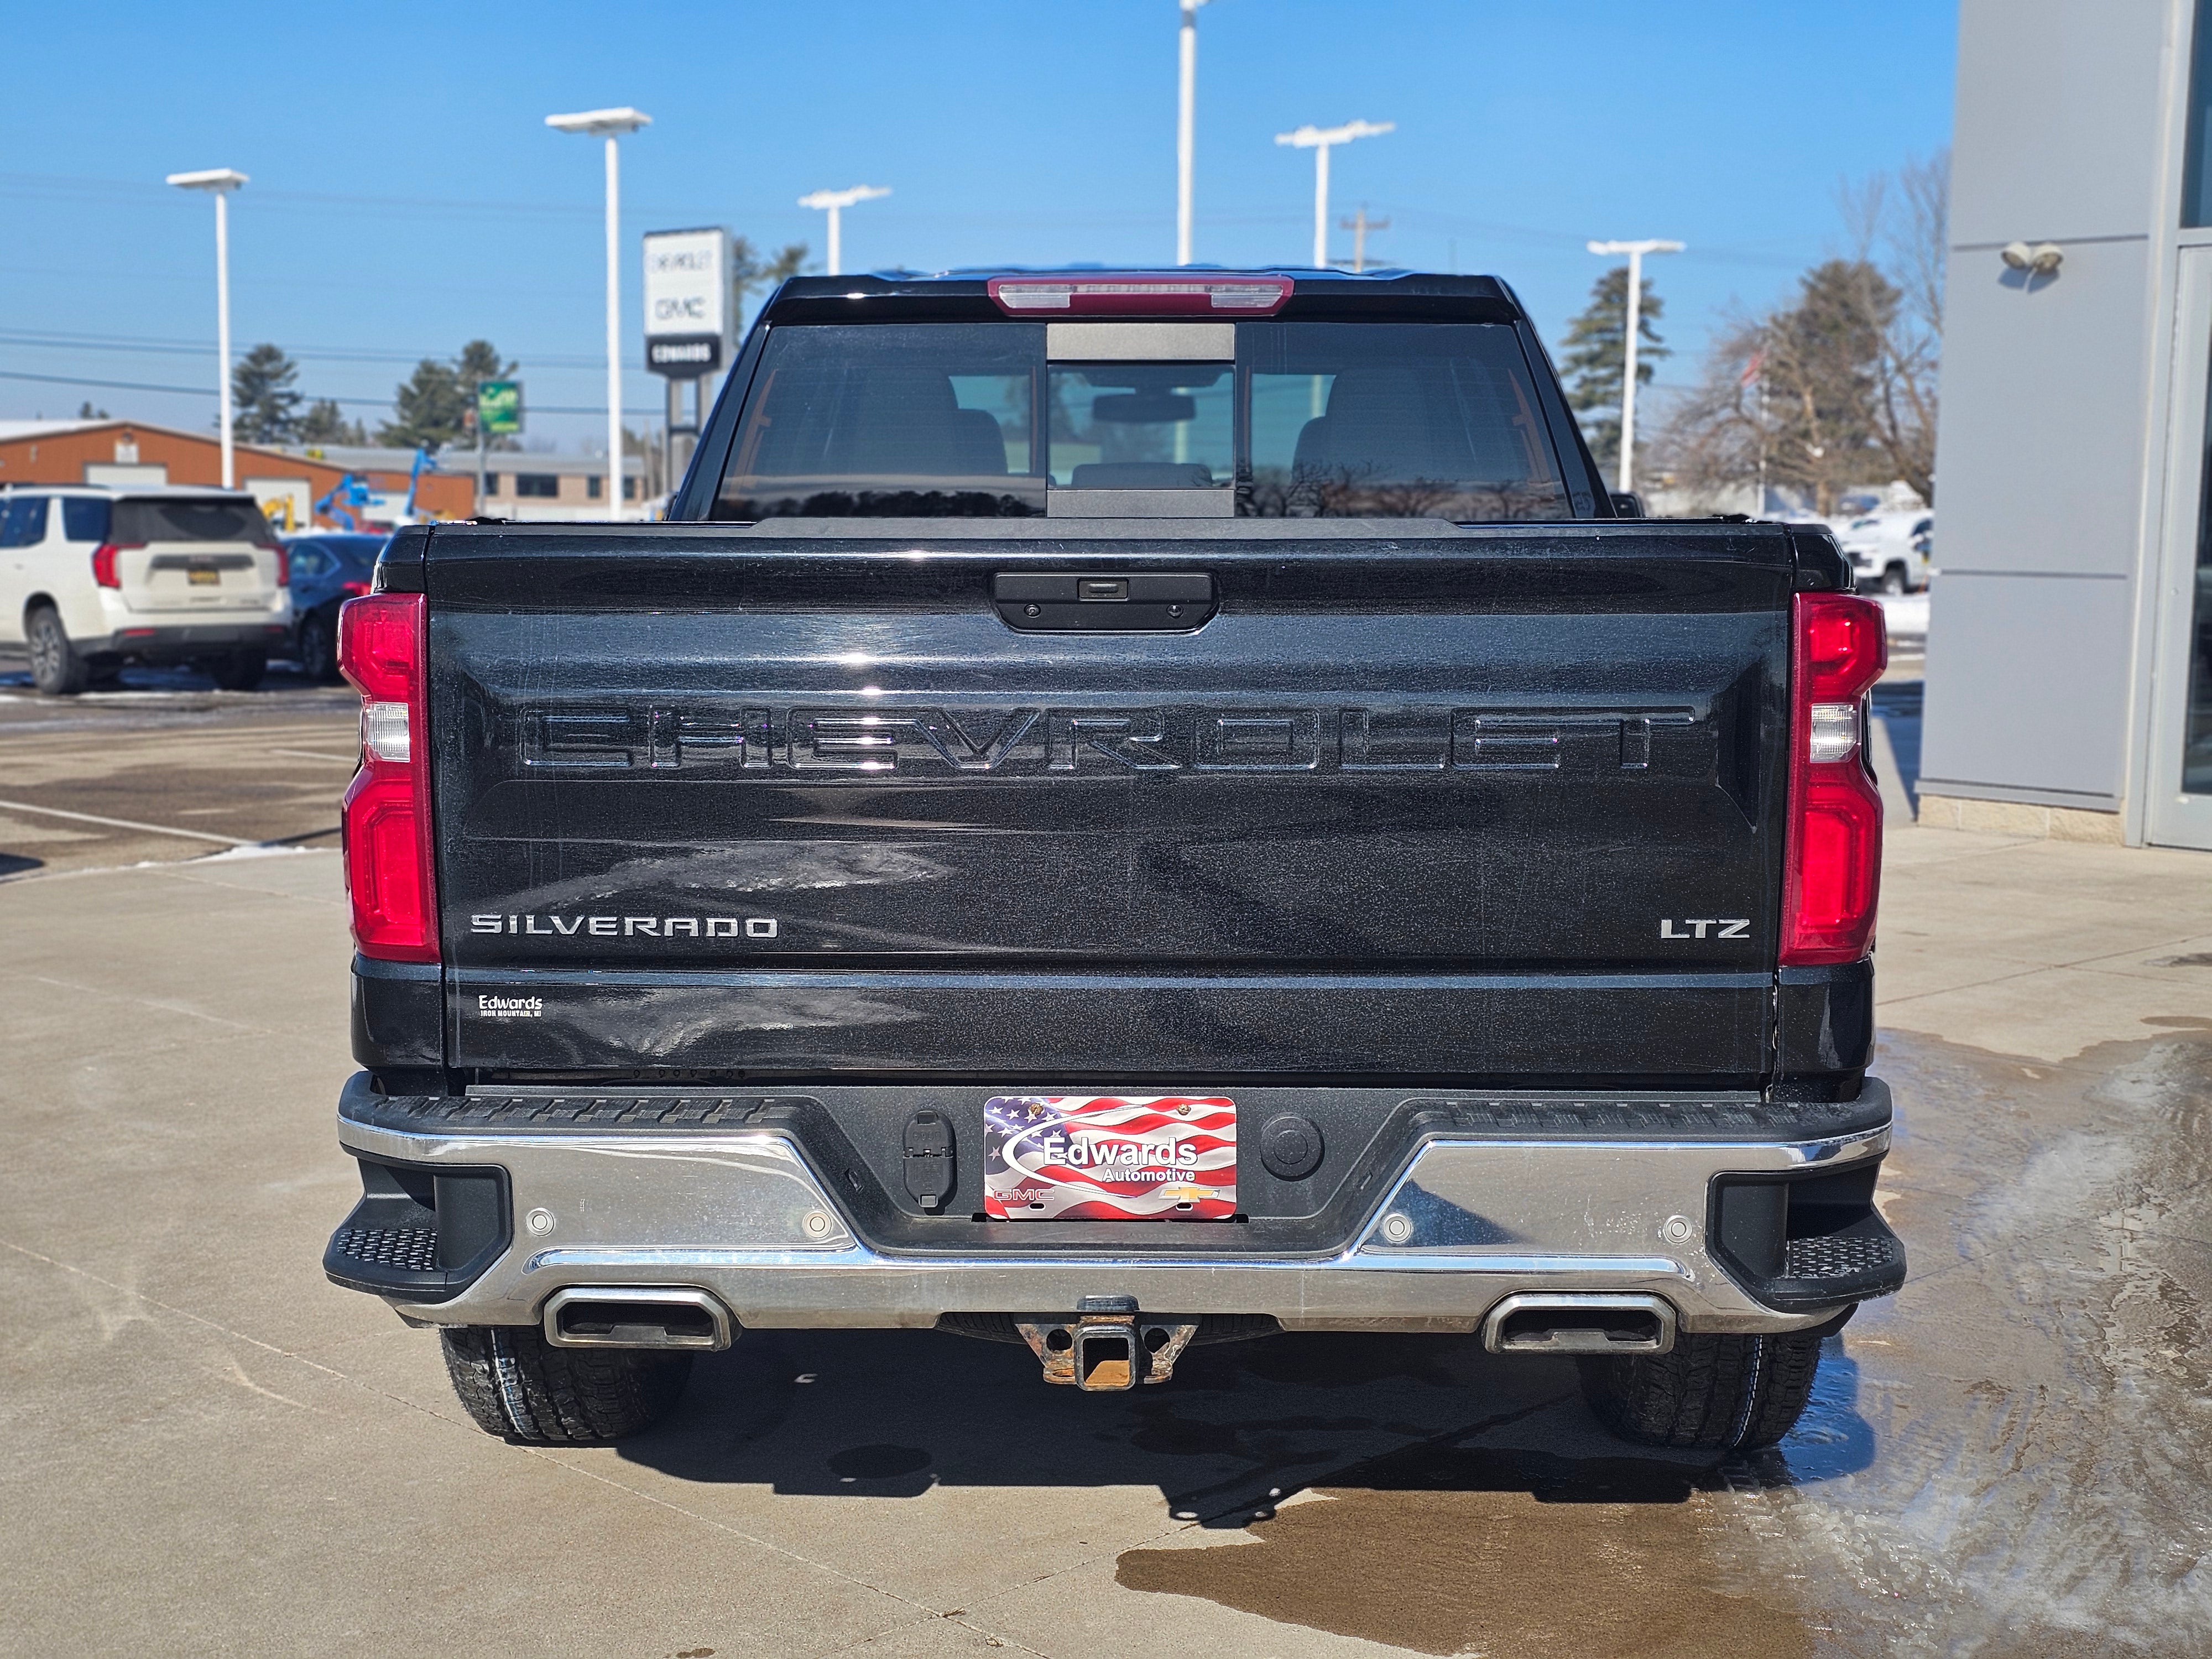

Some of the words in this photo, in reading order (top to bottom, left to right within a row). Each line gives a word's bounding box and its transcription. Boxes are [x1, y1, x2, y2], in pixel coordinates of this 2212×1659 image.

[519, 706, 1696, 770] CHEVROLET
[471, 914, 778, 938] SILVERADO
[1661, 919, 1750, 938] LTZ
[478, 995, 542, 1010] Edwards
[1043, 1136, 1198, 1166] Edwards
[1102, 1168, 1196, 1182] Automotive
[993, 1188, 1055, 1201] GMC
